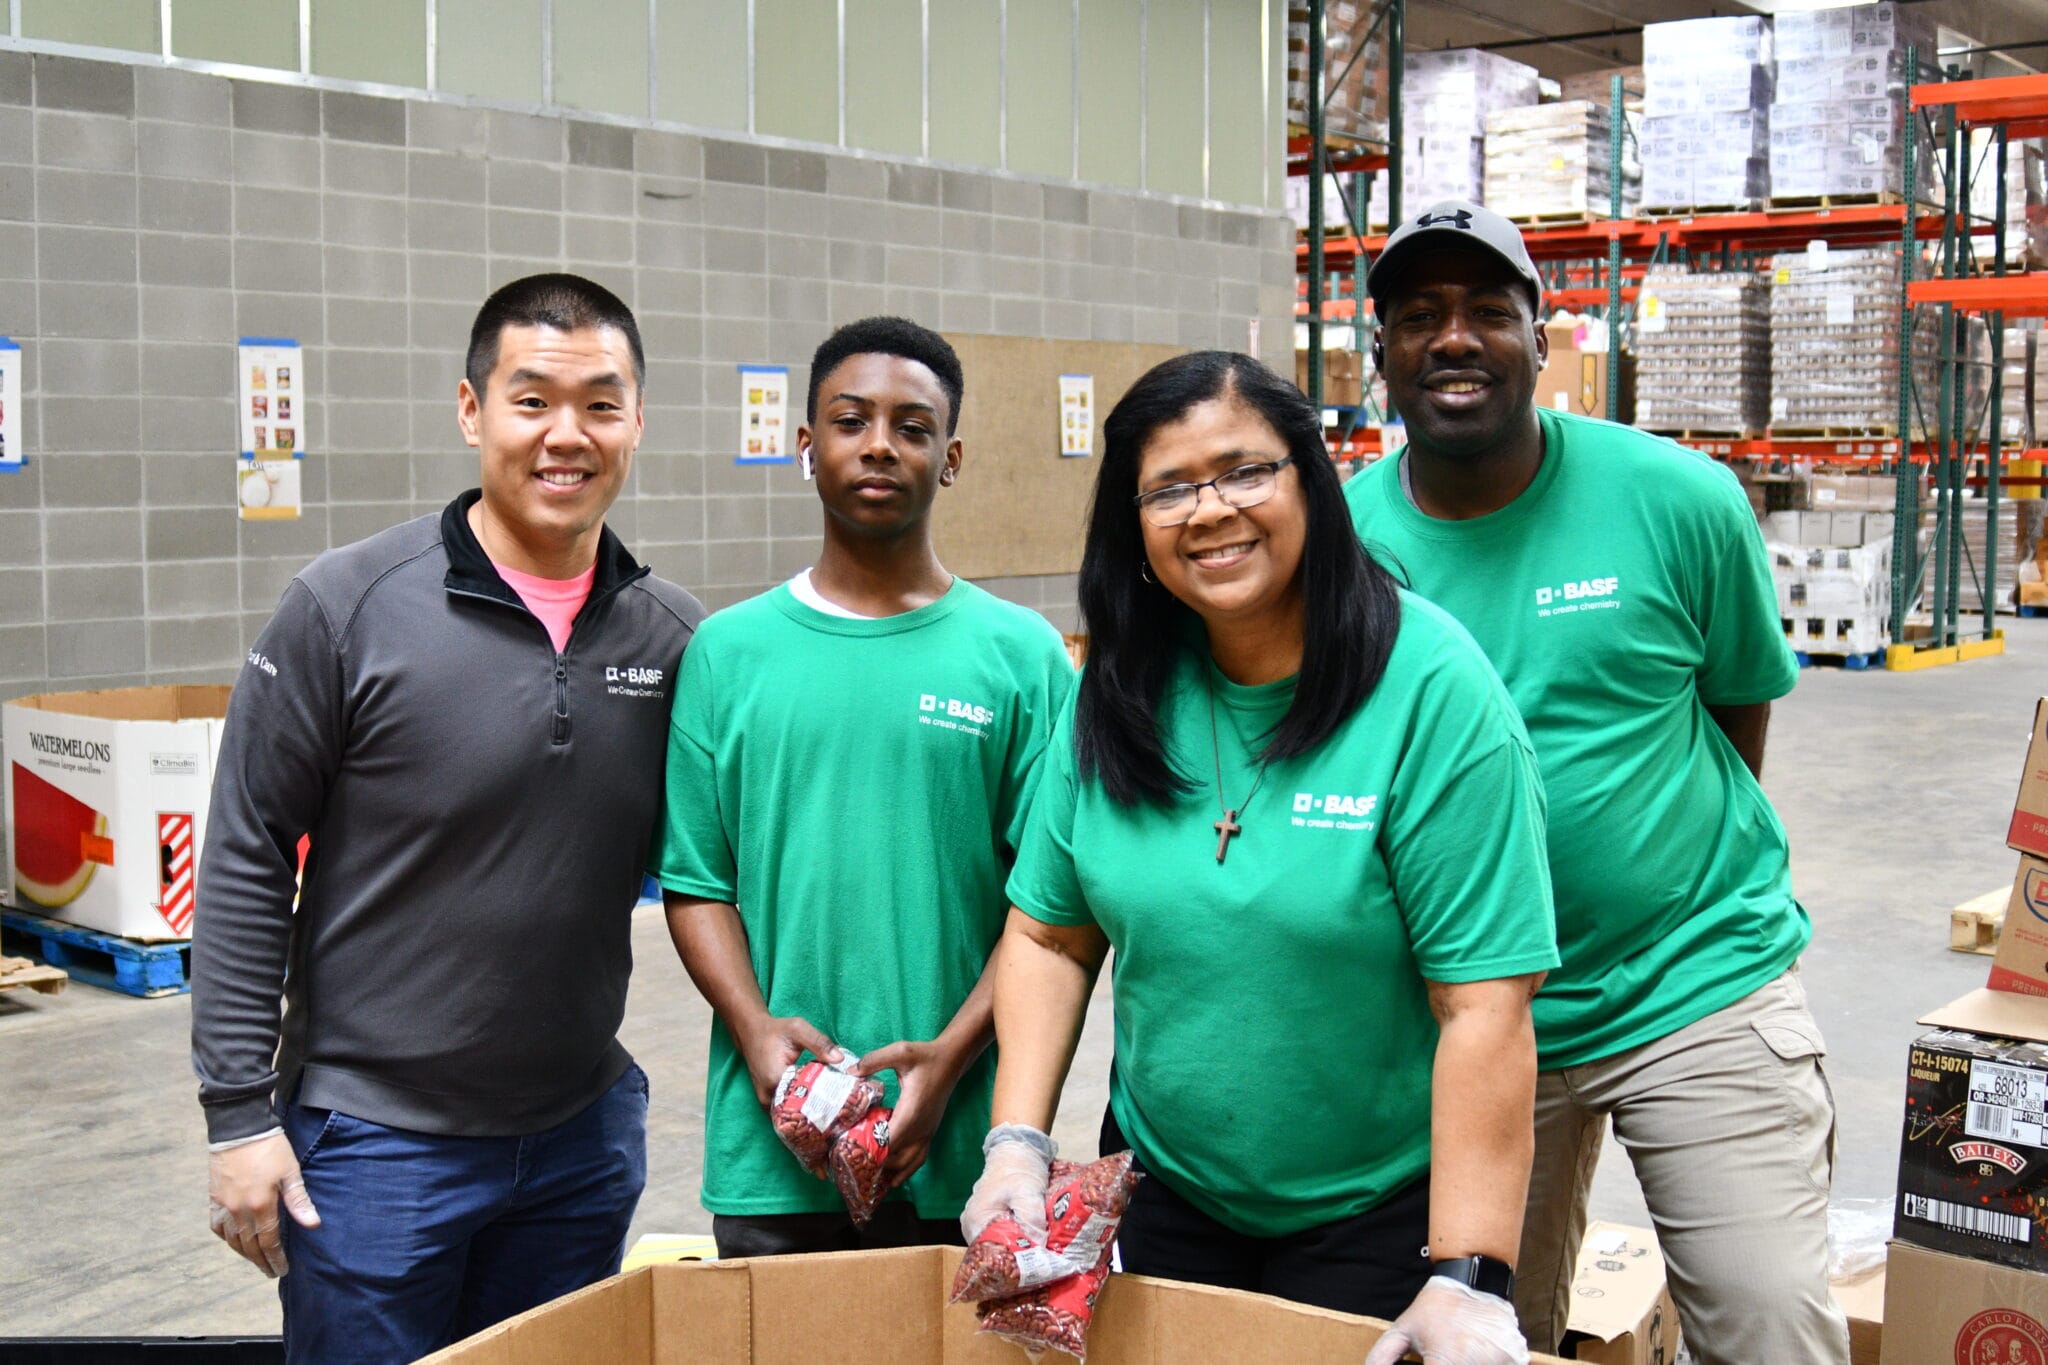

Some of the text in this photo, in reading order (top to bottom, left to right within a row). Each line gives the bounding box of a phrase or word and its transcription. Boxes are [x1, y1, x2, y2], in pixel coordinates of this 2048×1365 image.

[1563, 577, 1618, 600] BASF
[1537, 600, 1620, 617] We create chemistry
[628, 667, 663, 685] BASF
[608, 685, 618, 695] We
[947, 698, 994, 725] BASF
[919, 714, 989, 741] We create chemistry
[29, 732, 111, 763] WATERMELONS
[1323, 794, 1377, 816] BASF
[1291, 816, 1305, 827] We
[1335, 820, 1375, 831] chemistry
[1911, 1050, 1968, 1074] CT-I-15074
[1910, 1067, 1940, 1082] LIQUEUR
[1994, 1076, 2028, 1098] 68013
[1956, 1145, 2021, 1169] BAILEYS
[1916, 1196, 1927, 1208] 12
[1969, 1313, 2012, 1335] CARLO
